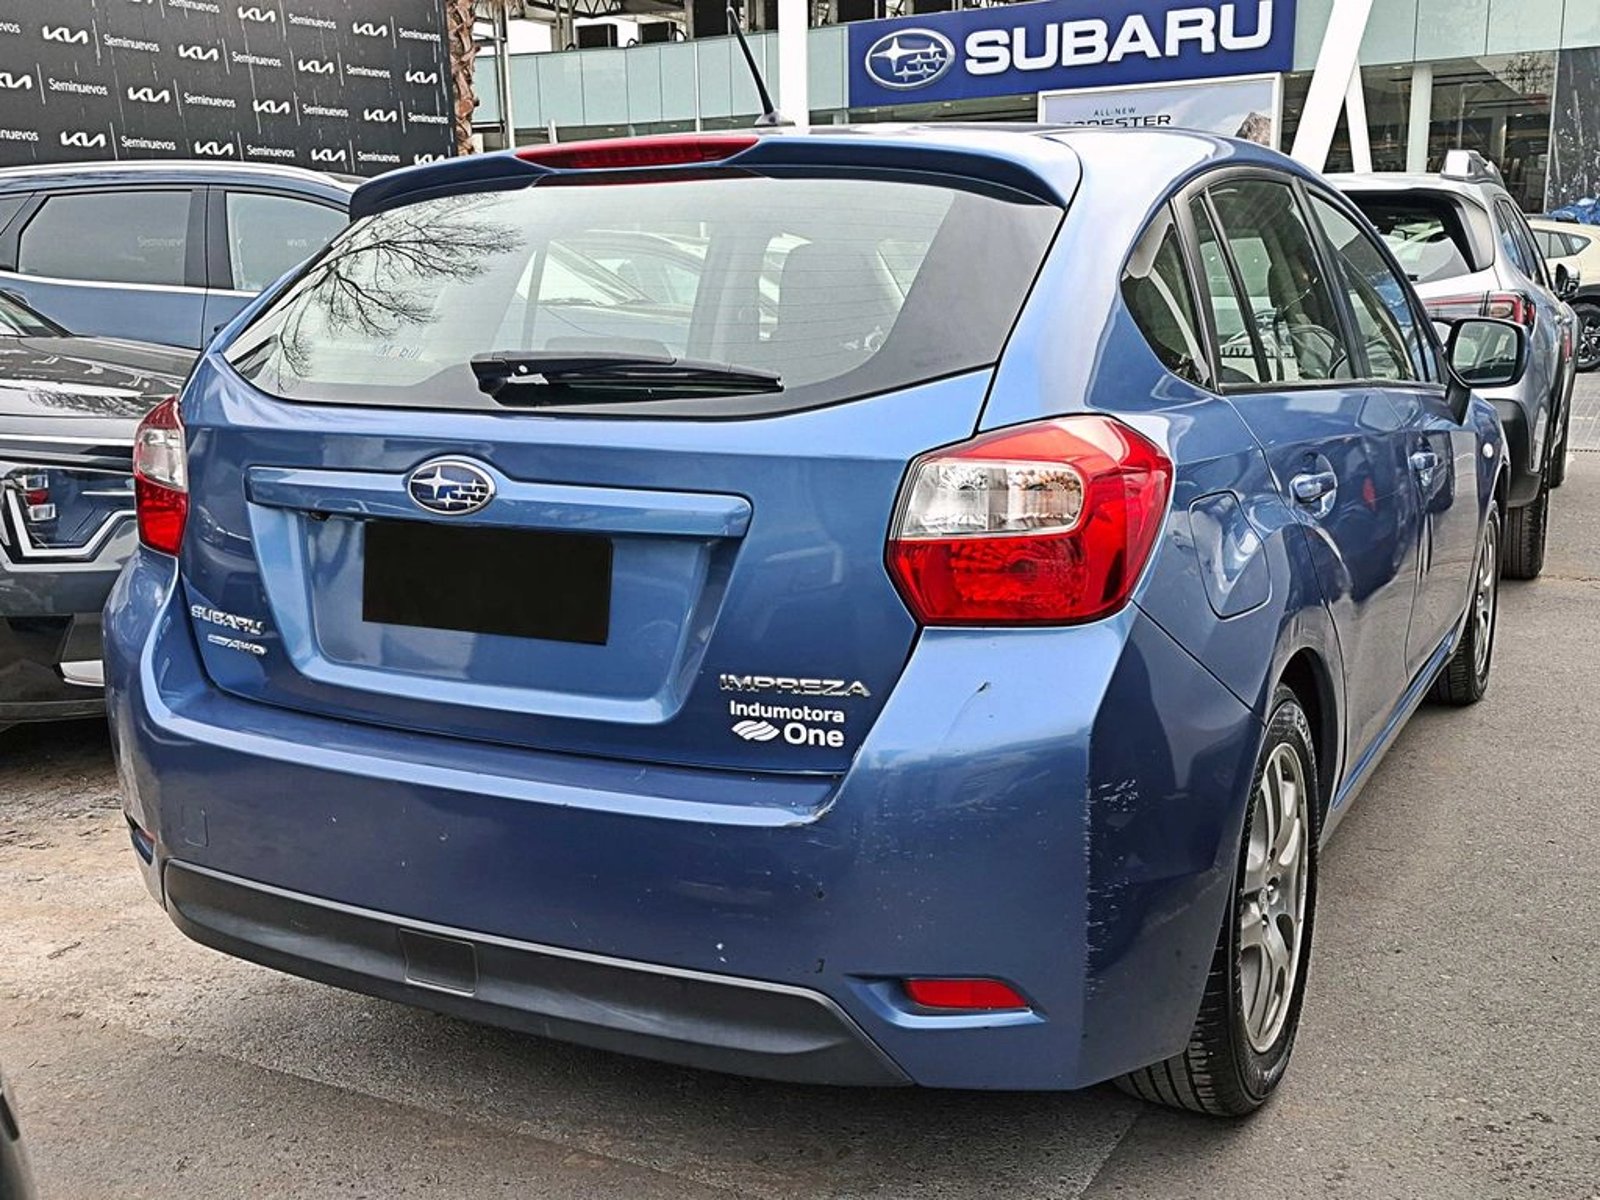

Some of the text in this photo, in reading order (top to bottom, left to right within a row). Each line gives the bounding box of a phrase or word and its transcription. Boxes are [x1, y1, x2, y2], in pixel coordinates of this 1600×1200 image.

[289, 13, 337, 29] Seminuevos
[104, 34, 160, 52] Seminuevos
[399, 28, 440, 42] Seminuevos
[965, 0, 1272, 75] SUBARU
[232, 51, 281, 67] Seminuevos
[347, 65, 390, 78] Seminuevos
[49, 78, 108, 95] Seminuevos
[184, 92, 236, 108] Seminuevos
[302, 104, 349, 117] Seminuevos
[408, 112, 448, 124] Seminuevos
[1063, 115, 1171, 127] RESTER
[121, 136, 176, 150] Seminuevos
[247, 145, 295, 158] Seminuevos
[357, 151, 400, 163] Seminuevos
[719, 673, 871, 697] IMPREZA
[730, 700, 844, 722] Indumotora
[784, 722, 844, 747] One
